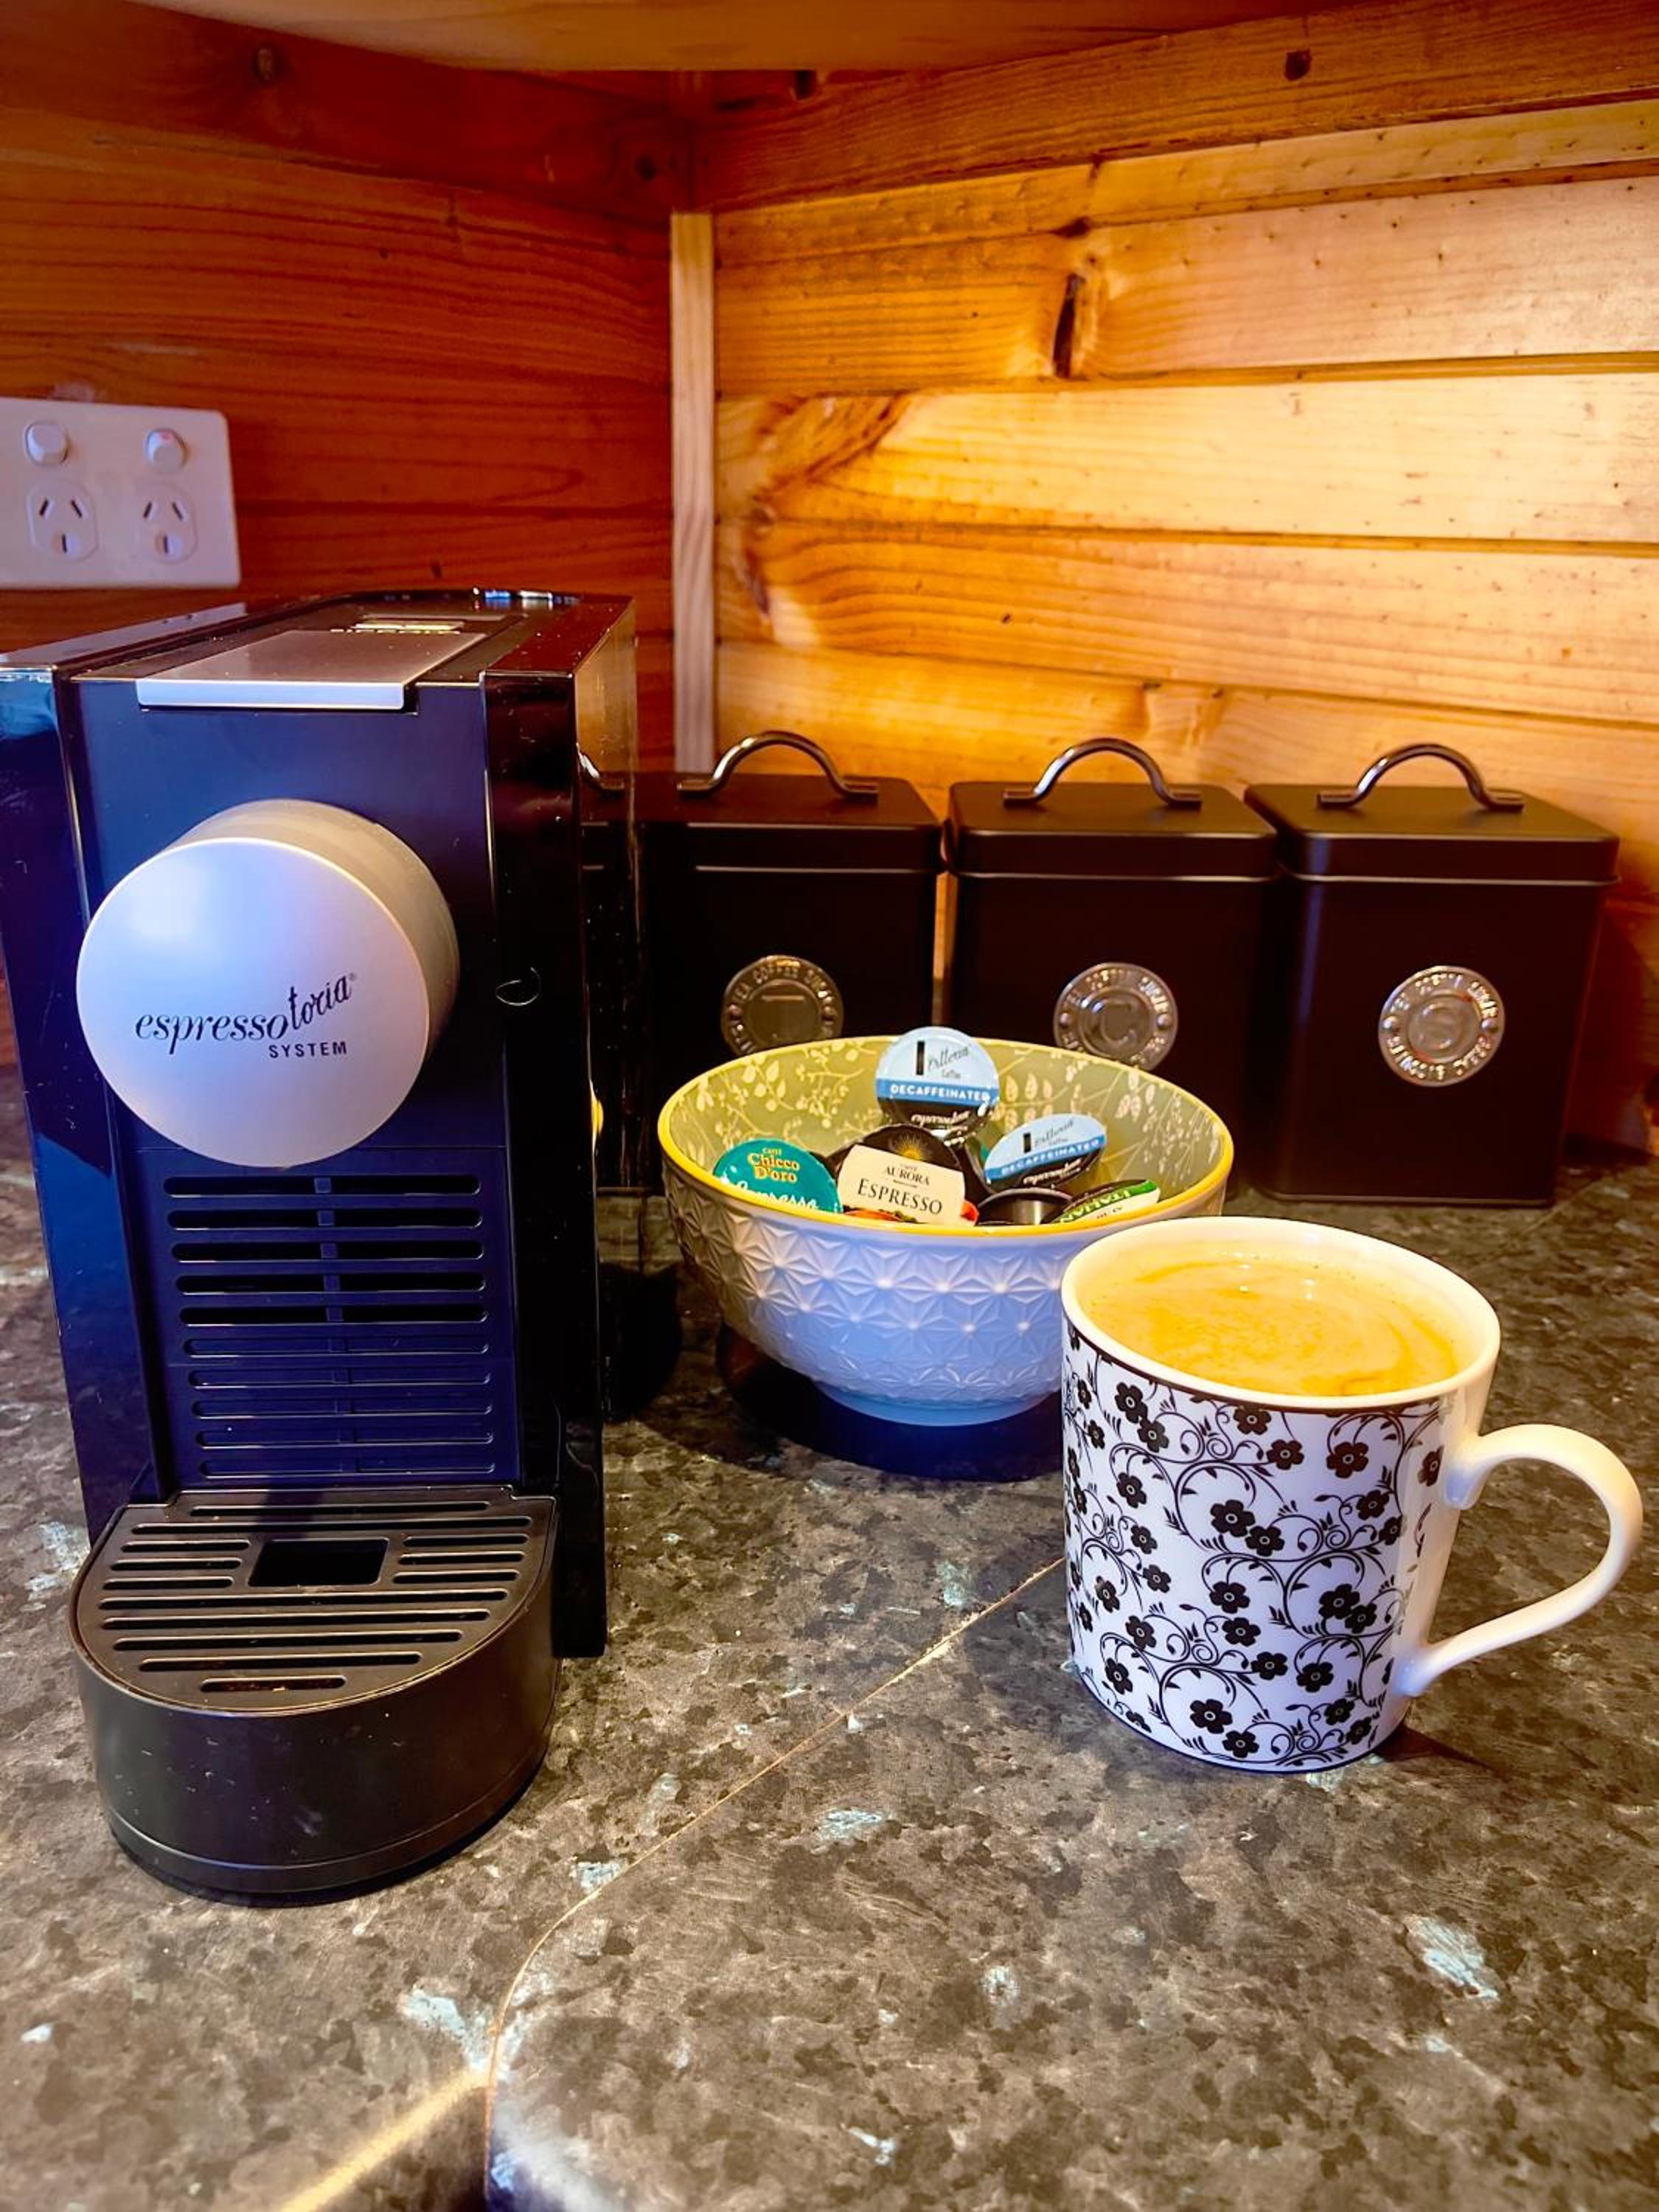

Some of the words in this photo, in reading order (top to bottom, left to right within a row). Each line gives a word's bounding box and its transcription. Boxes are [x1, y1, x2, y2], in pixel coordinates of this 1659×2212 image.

[268, 1041, 348, 1059] SYSTEM
[890, 1084, 992, 1102] DECAFFEINATED
[747, 1152, 800, 1171] Chicco
[1001, 1138, 1100, 1175] DECAFFEINATED
[884, 1166, 931, 1186] AURORA
[858, 1178, 944, 1215] ESPRESSO
